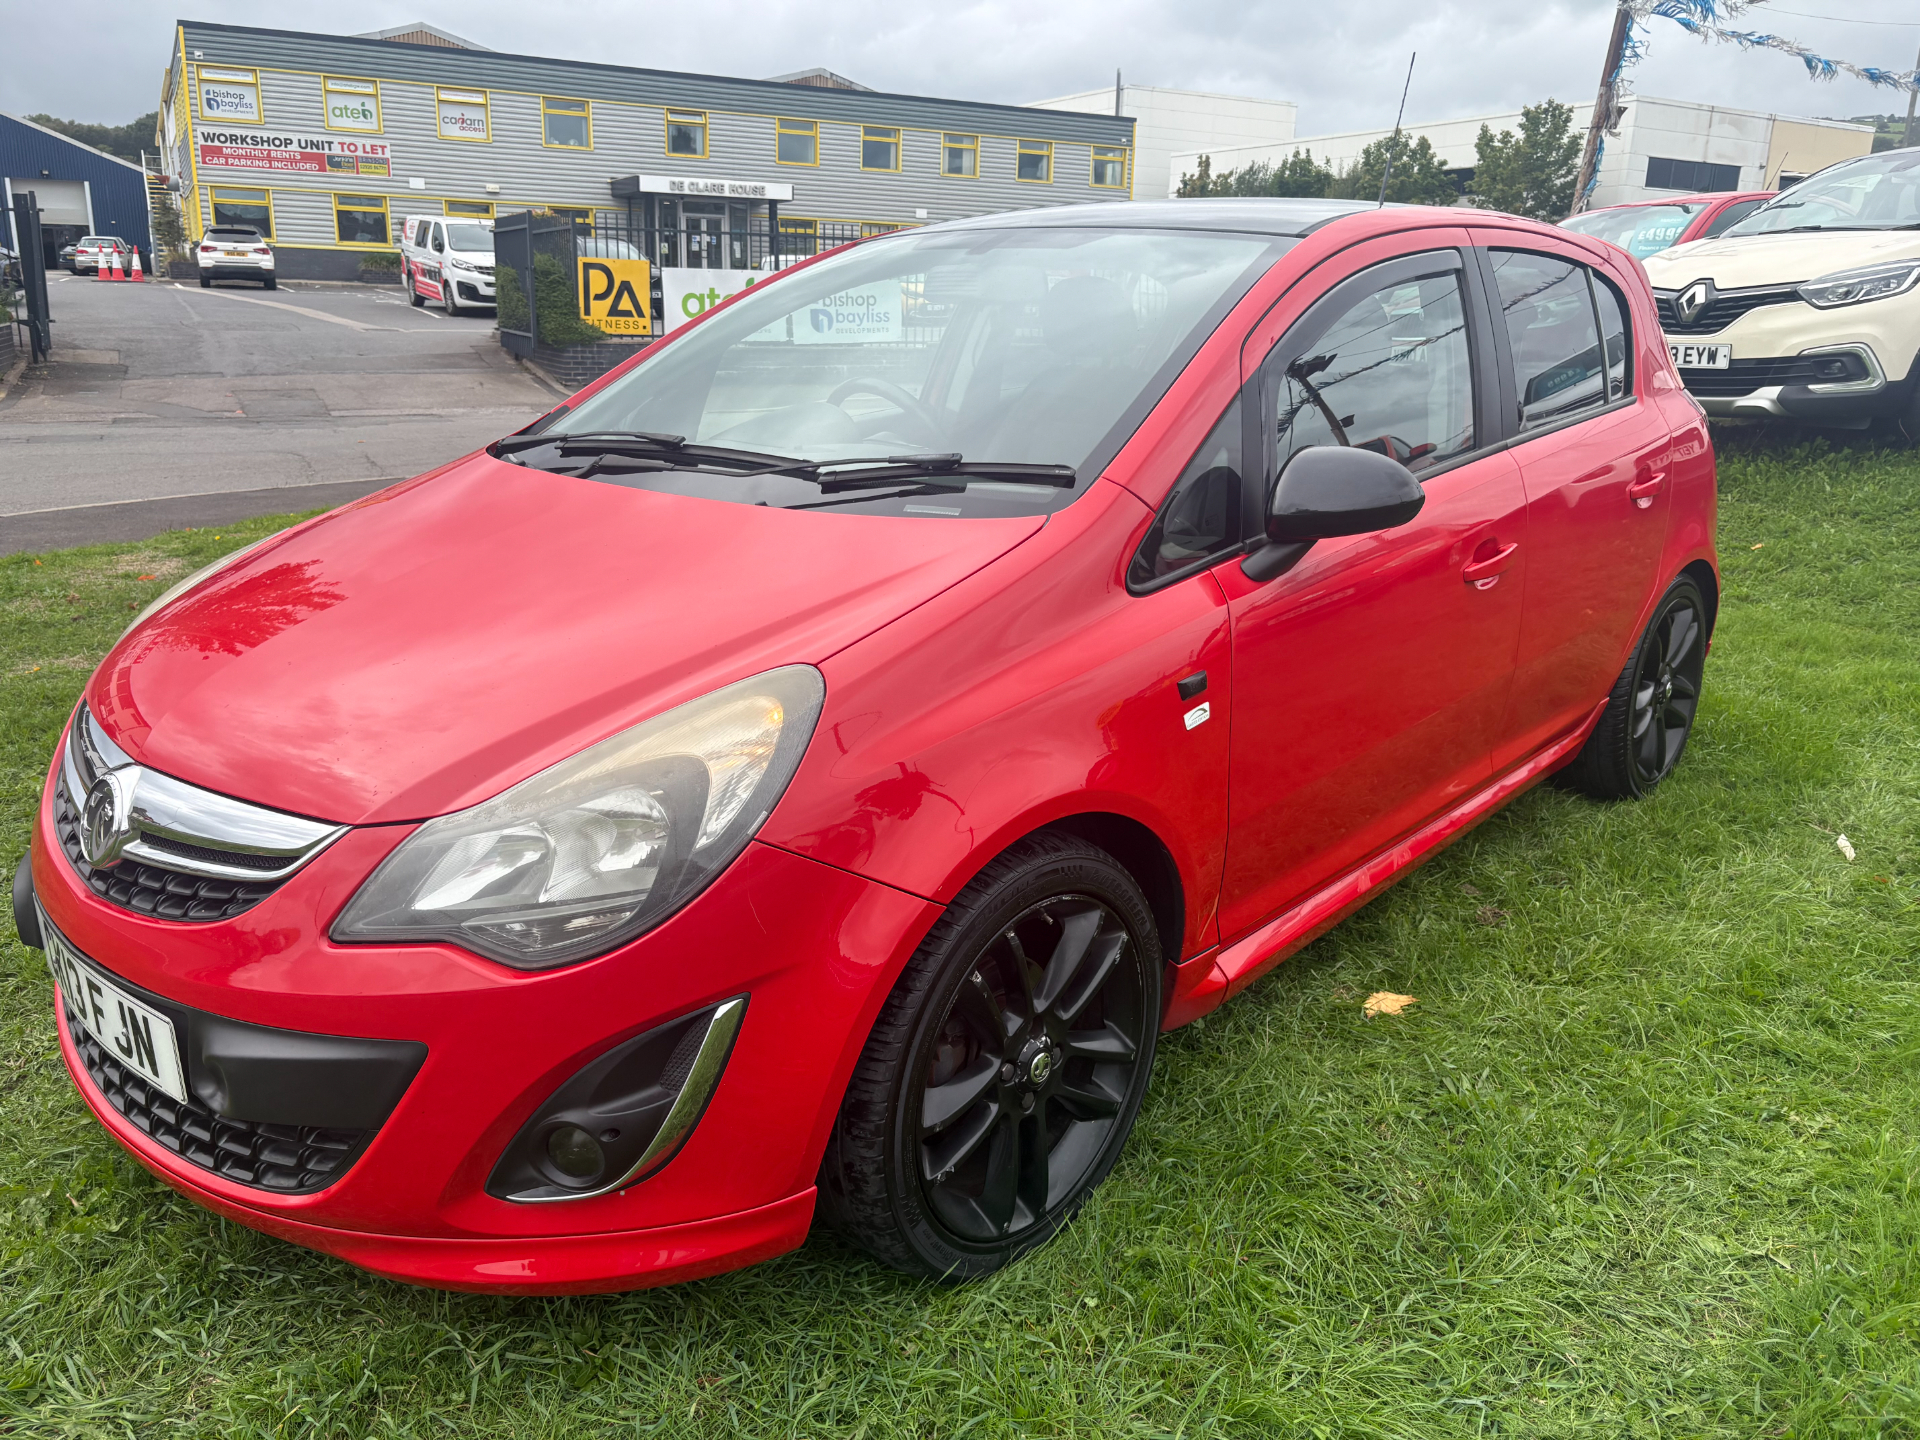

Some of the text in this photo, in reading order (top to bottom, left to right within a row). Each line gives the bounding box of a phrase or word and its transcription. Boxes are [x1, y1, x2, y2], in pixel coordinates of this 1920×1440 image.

[212, 89, 245, 103] bishop
[220, 99, 254, 110] bayliss
[458, 125, 486, 133] access
[201, 132, 387, 156] WORKSHOP UNIT TO LET
[222, 146, 301, 160] MONTHLY RENTS
[205, 156, 319, 171] CAR PARKING INCLUDED
[669, 180, 766, 196] DE CLARE HOUSE
[822, 291, 877, 312] bishop
[835, 308, 890, 327] bayliss
[835, 327, 890, 335] DEVELOPMENTS
[1682, 346, 1719, 365] EYW
